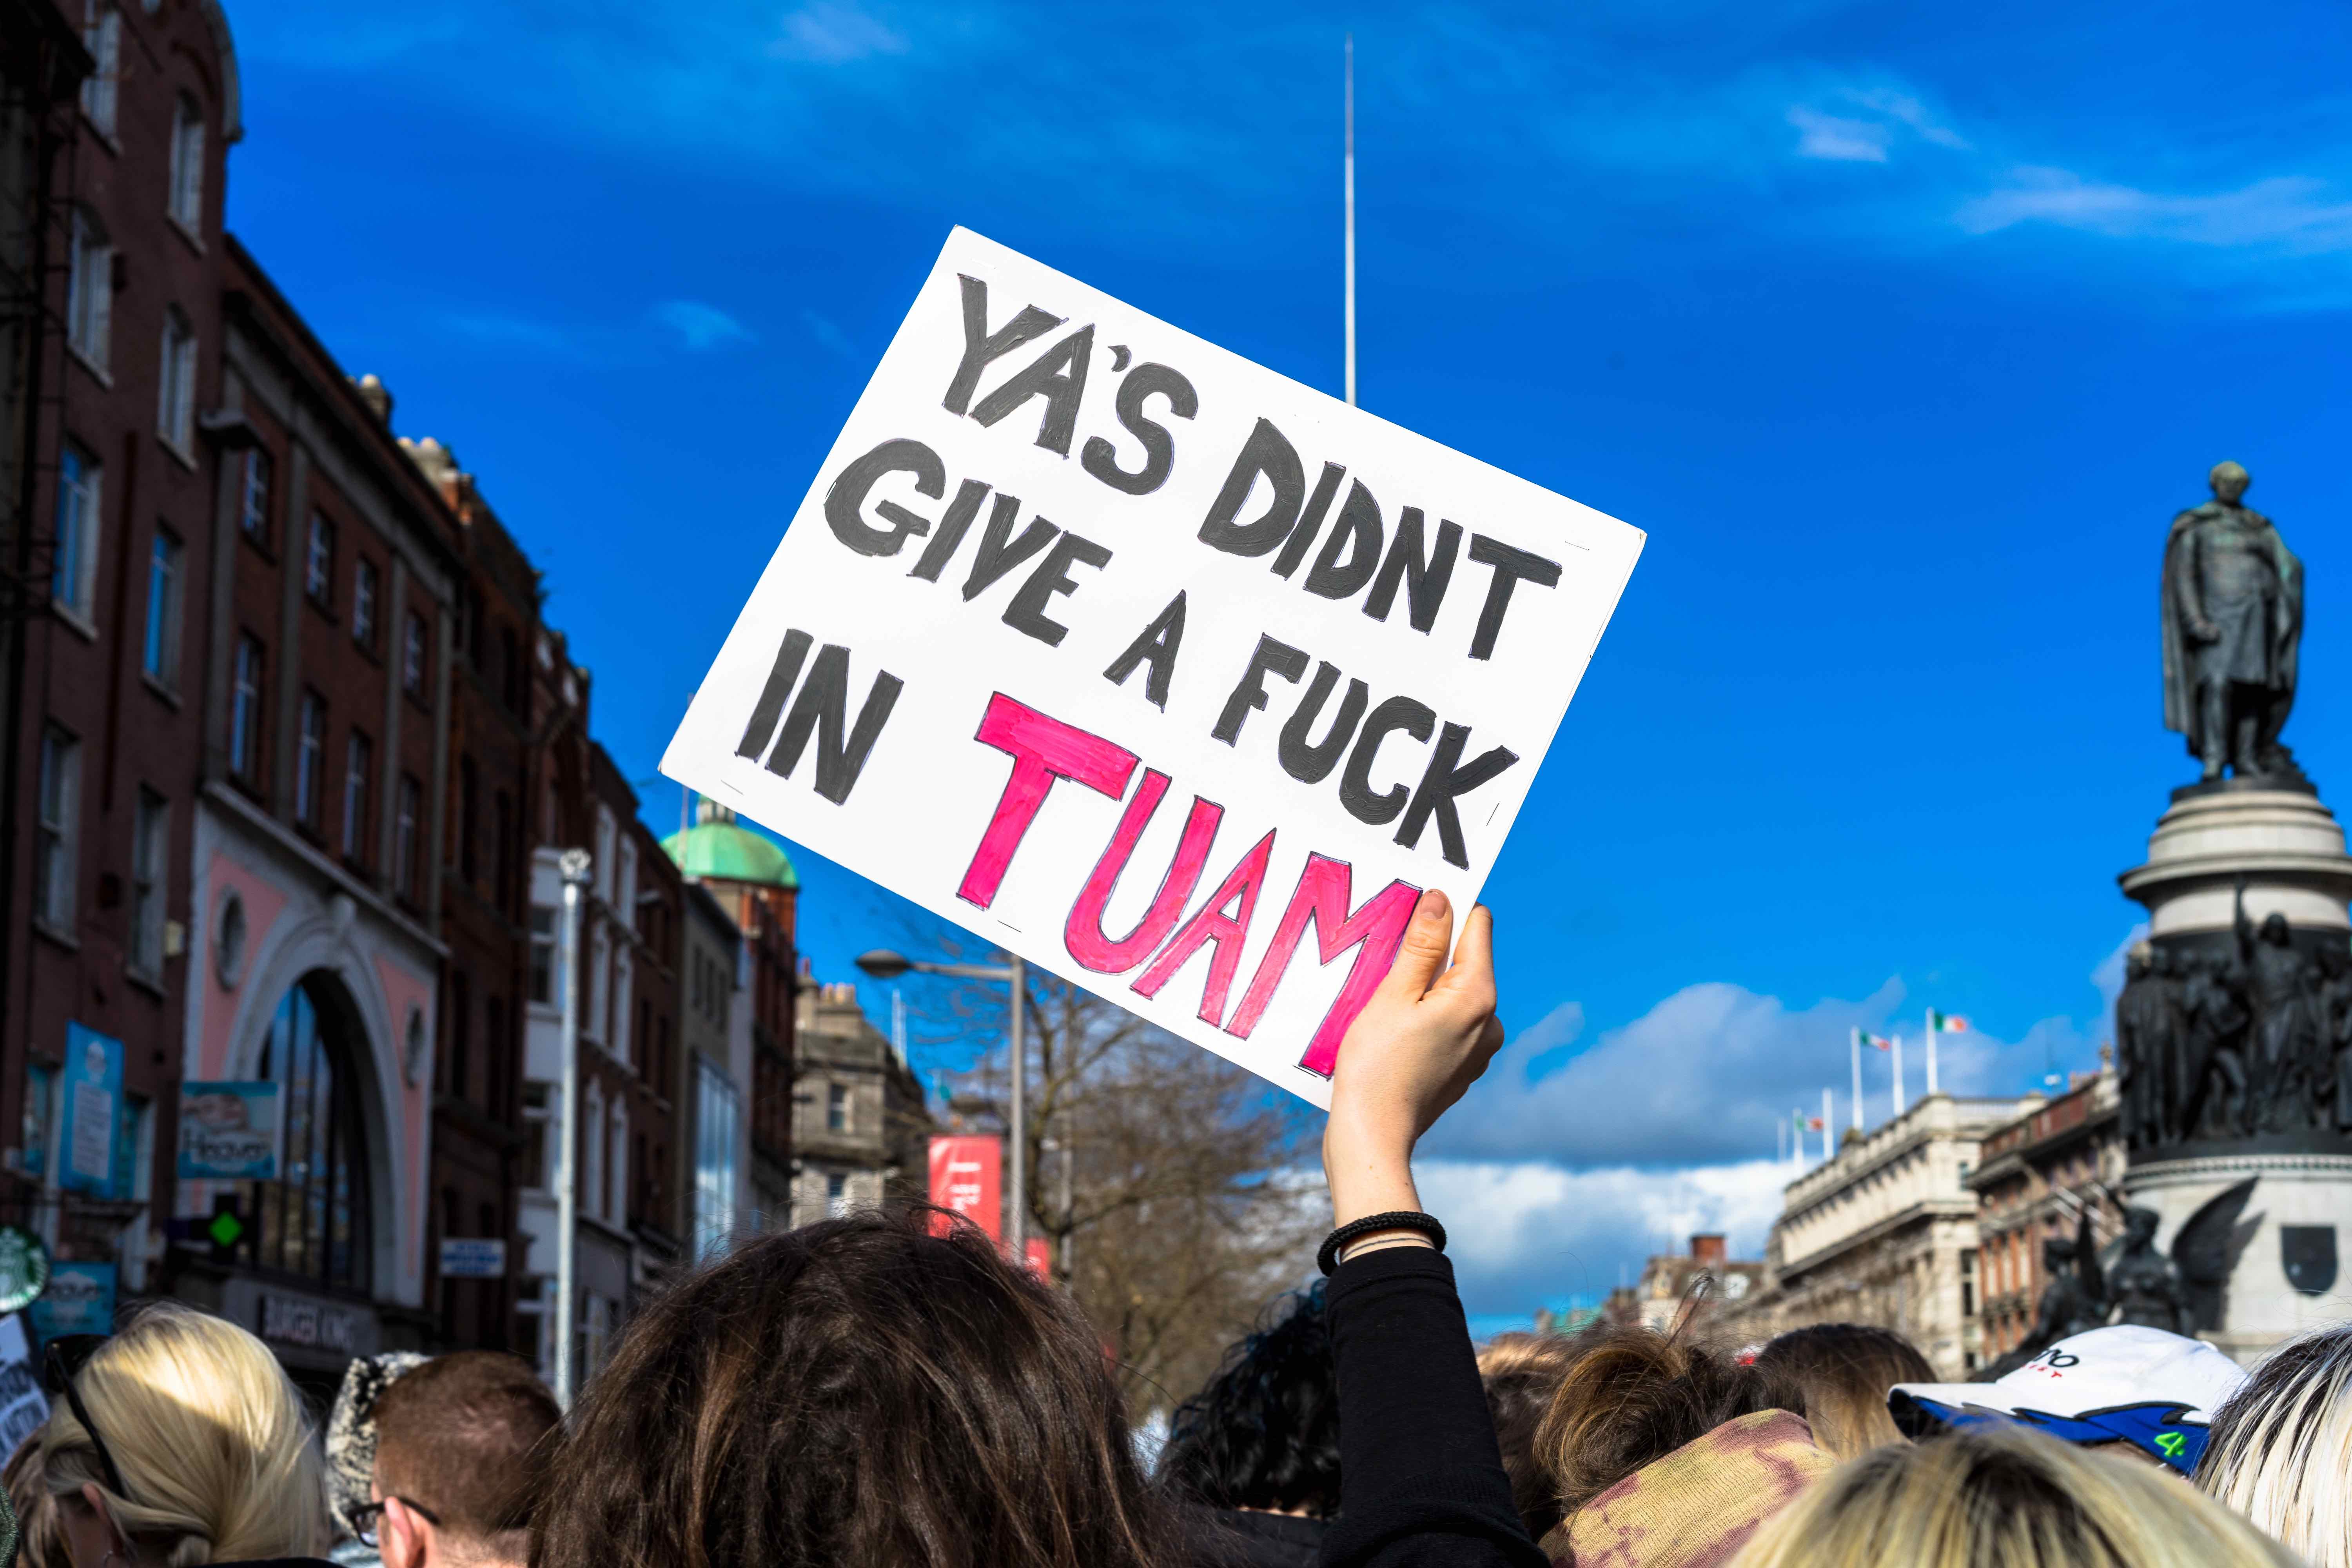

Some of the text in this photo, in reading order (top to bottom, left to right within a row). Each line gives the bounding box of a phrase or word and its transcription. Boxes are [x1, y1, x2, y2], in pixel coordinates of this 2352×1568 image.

[822, 437, 1521, 870] GIVE A FUCK
[943, 271, 1564, 662] YA'S DIDNT
[735, 628, 1425, 1079] IN TUAM
